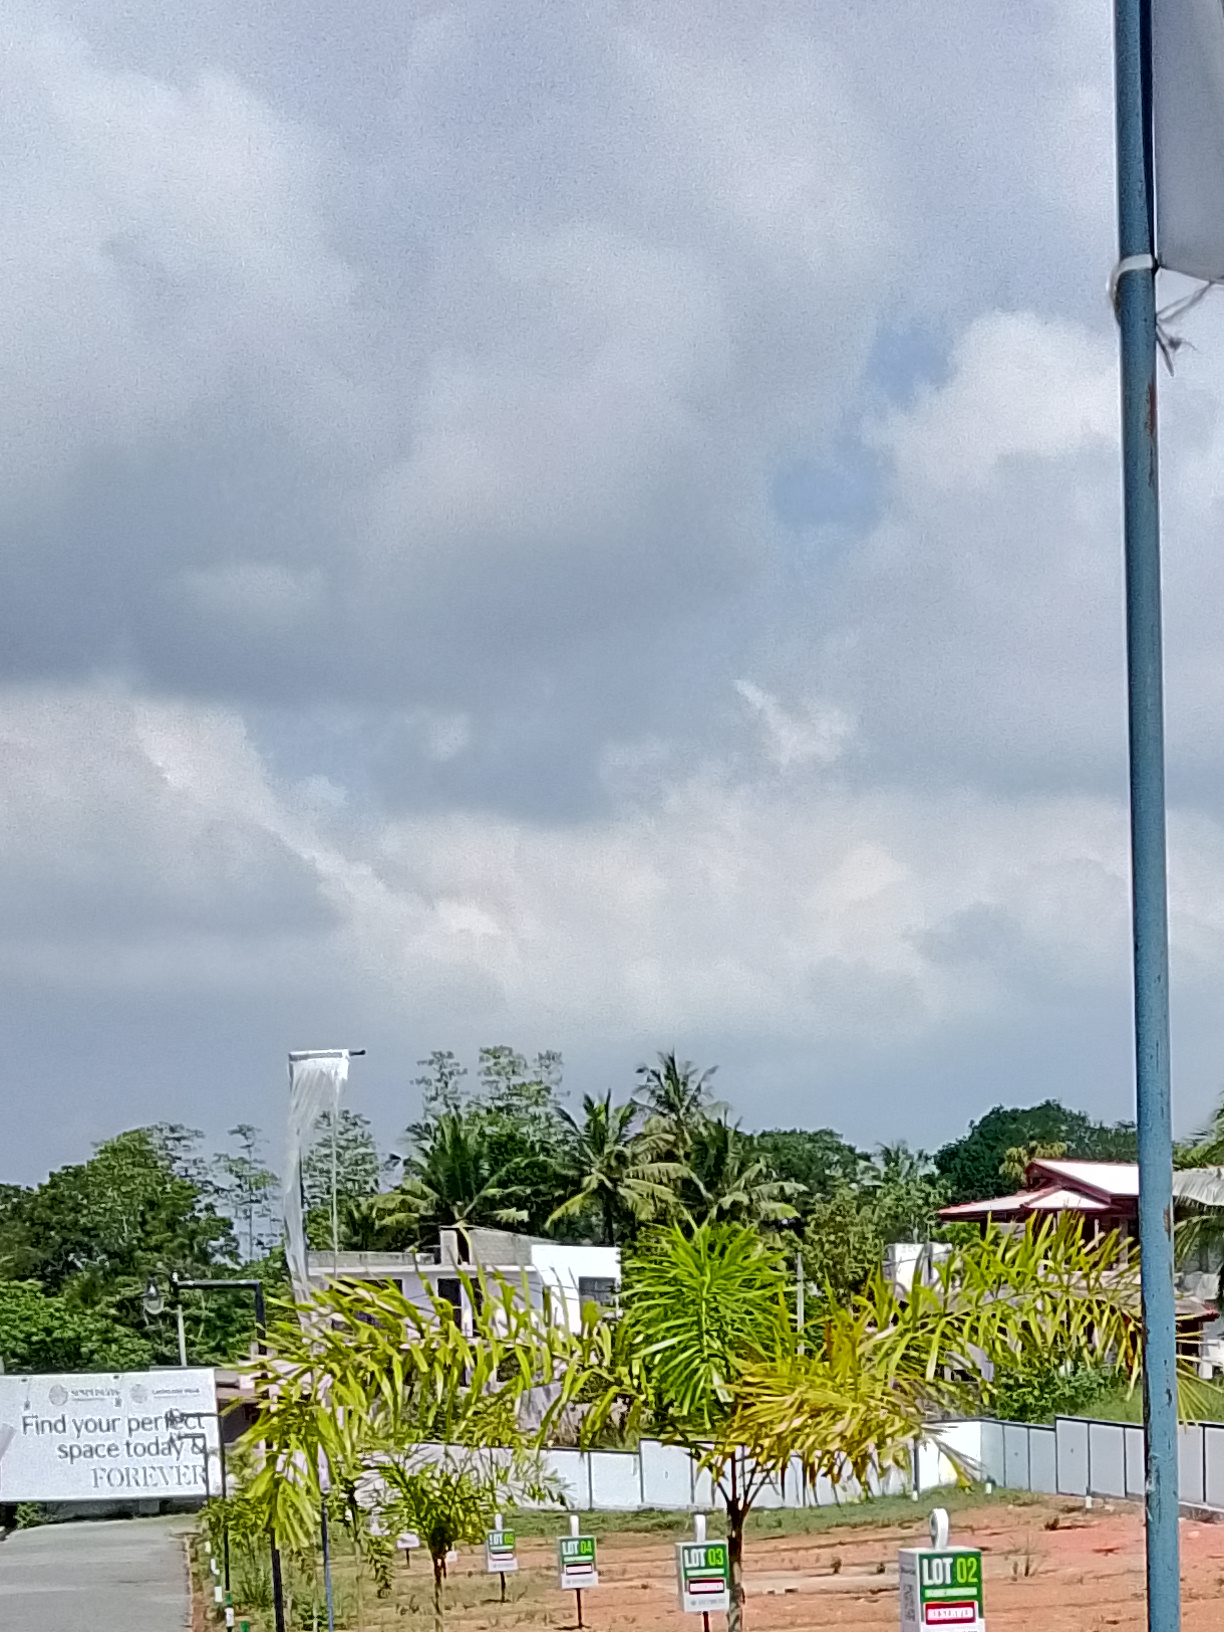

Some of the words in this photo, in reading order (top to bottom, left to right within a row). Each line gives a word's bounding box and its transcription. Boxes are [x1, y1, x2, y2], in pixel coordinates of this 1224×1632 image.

[21, 1414, 67, 1435] Find
[72, 1416, 121, 1439] your
[126, 1411, 205, 1438] perfect
[57, 1442, 120, 1465] space
[125, 1435, 185, 1461] today
[92, 1465, 206, 1488] FOREVER
[562, 1540, 580, 1556] LOT
[580, 1539, 593, 1555] 04
[683, 1548, 706, 1569] LOT
[707, 1547, 724, 1567] 03
[922, 1557, 953, 1586] LOT
[956, 1557, 979, 1584] 02
